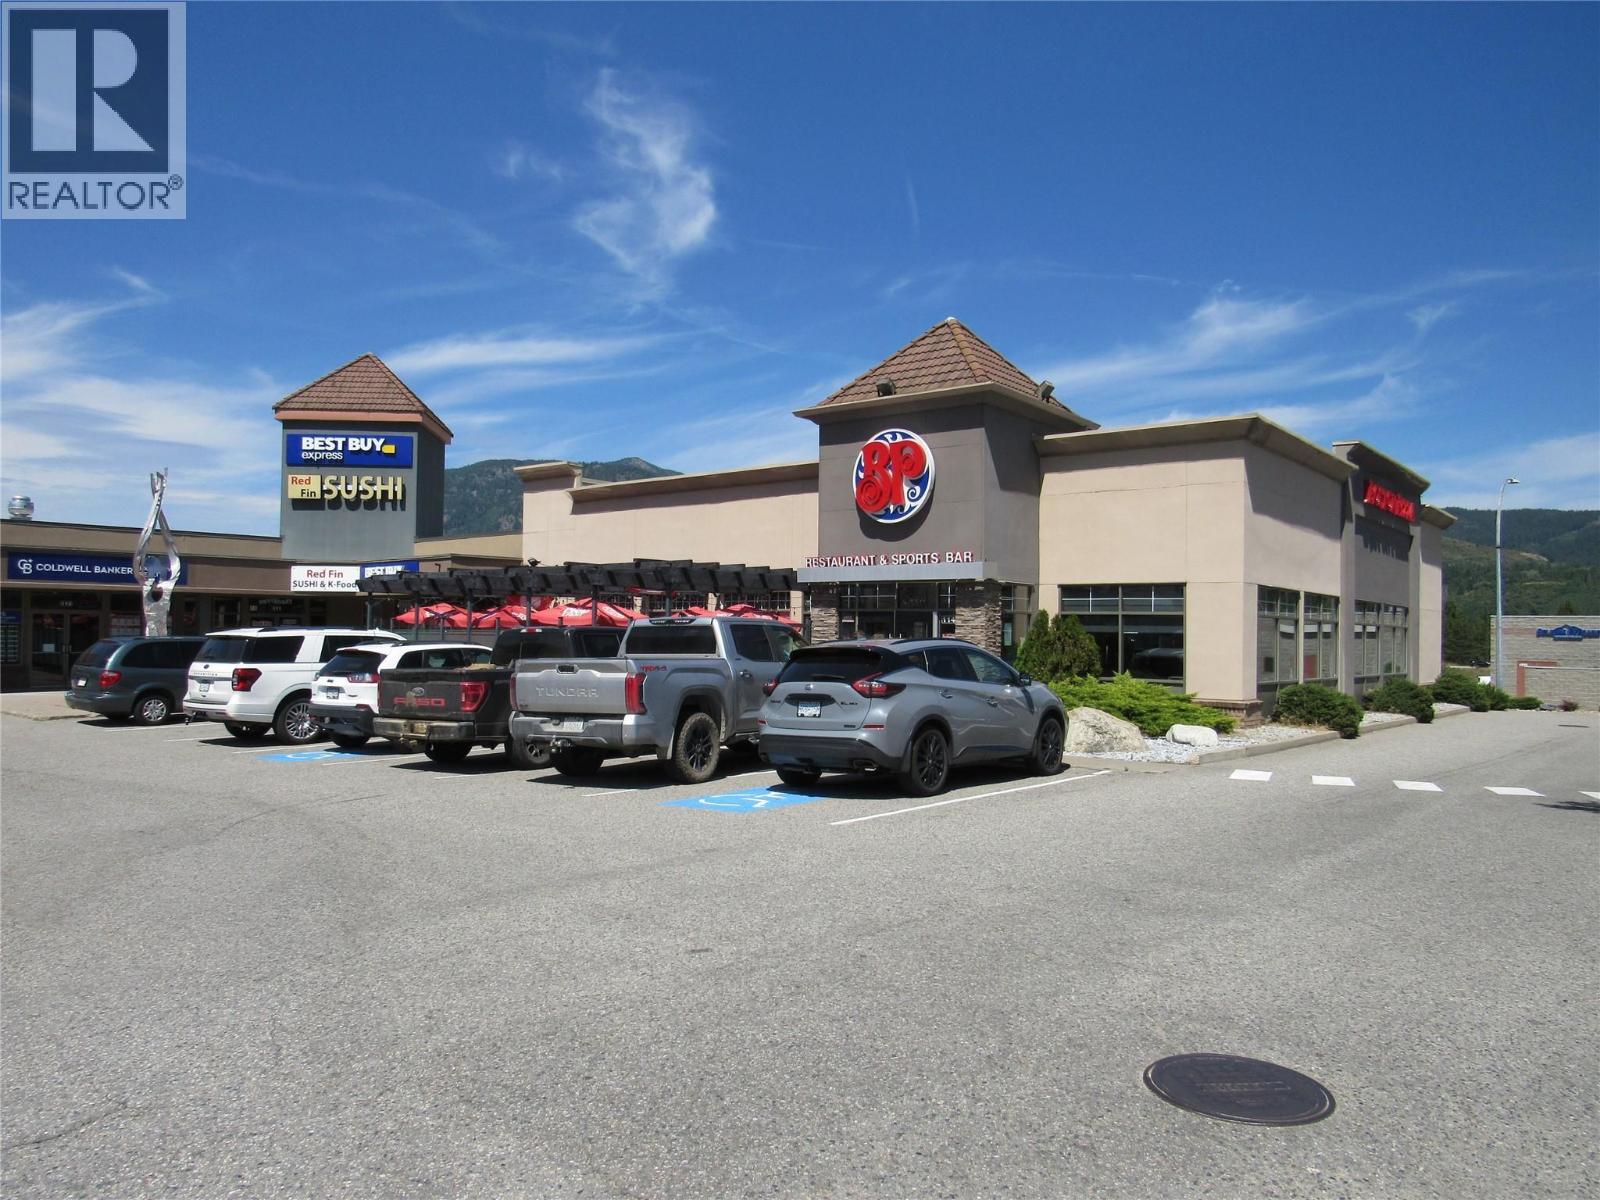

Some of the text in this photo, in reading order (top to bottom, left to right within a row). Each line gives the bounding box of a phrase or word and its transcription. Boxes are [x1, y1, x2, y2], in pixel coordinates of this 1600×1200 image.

[302, 437, 386, 451] BEST BUY
[301, 451, 344, 461] express
[291, 475, 402, 500] Red SUSHI
[300, 489, 317, 498] Fin
[805, 551, 973, 568] RESTAURANT & SPORTS BAR
[36, 563, 92, 574] COLDWELL
[94, 566, 133, 575] BANKER
[306, 569, 344, 579] Red Fin
[292, 580, 318, 588] SUSHI
[319, 580, 326, 588] &
[535, 686, 600, 698] TUNDRA
